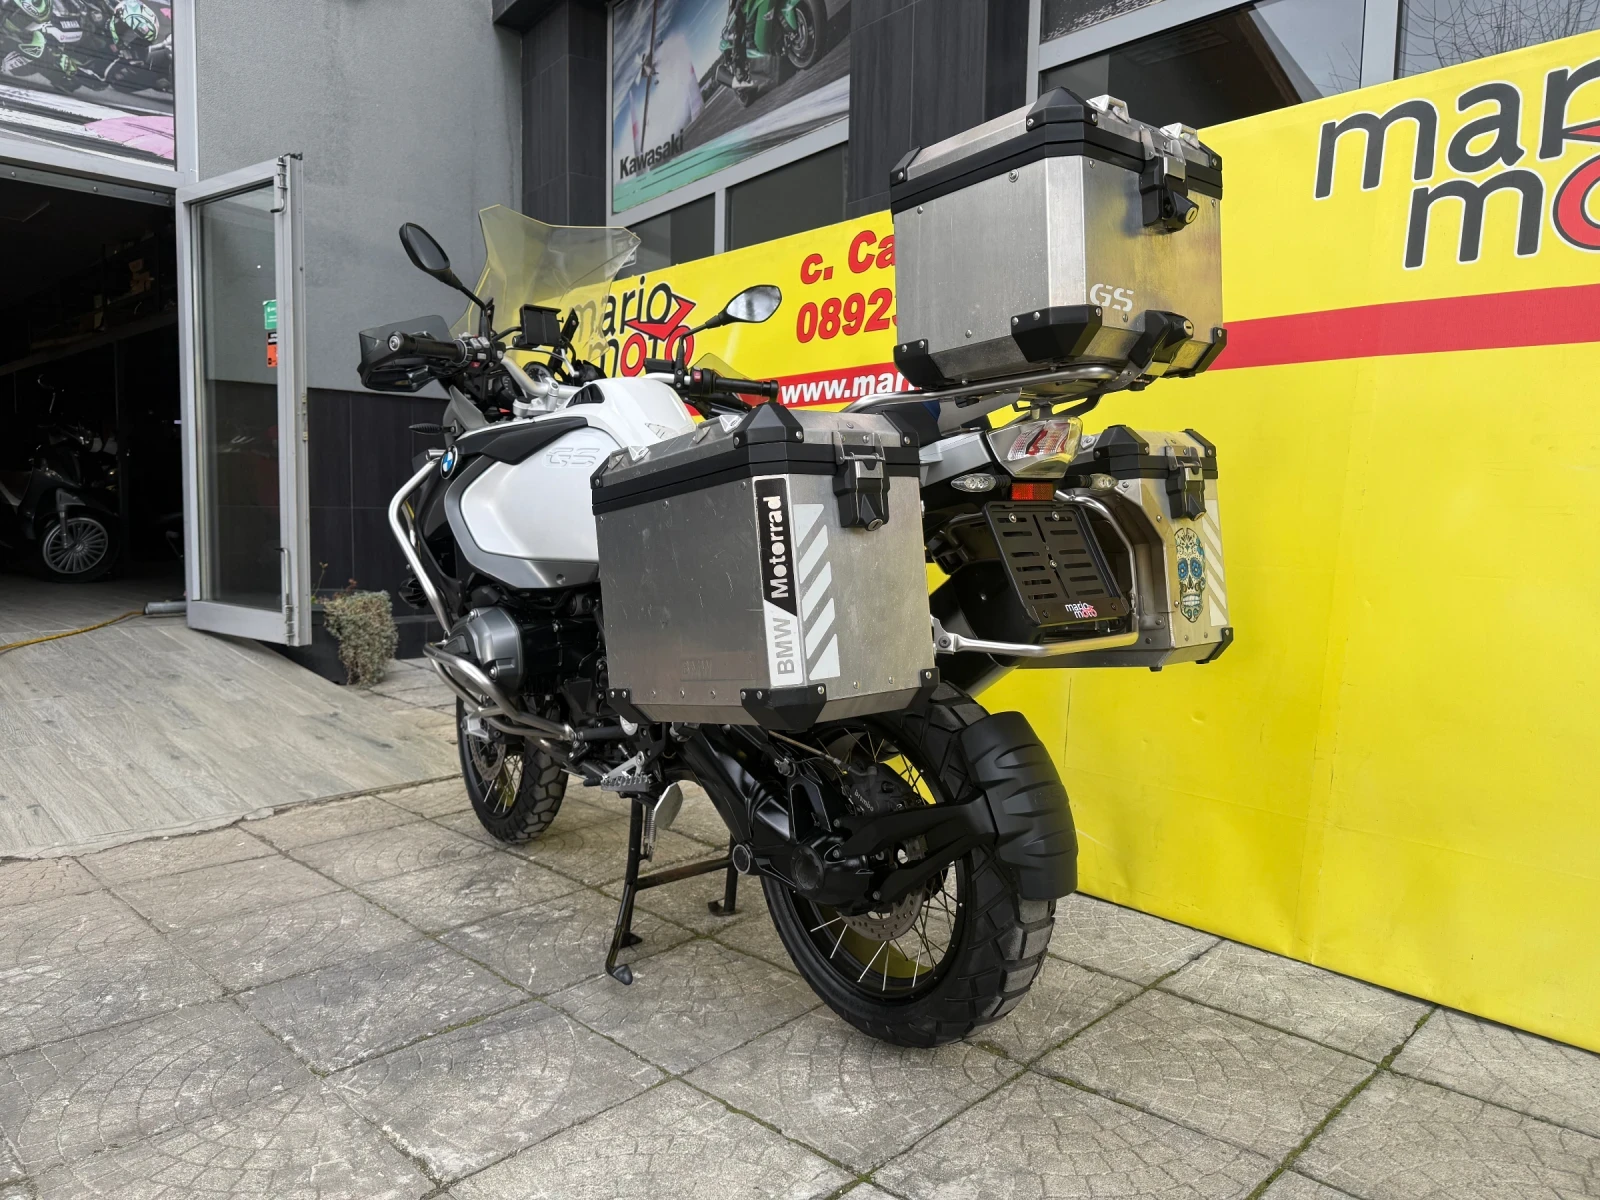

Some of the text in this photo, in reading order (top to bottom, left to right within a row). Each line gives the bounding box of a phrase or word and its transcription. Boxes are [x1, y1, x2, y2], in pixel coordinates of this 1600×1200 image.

[620, 128, 683, 179] Kawasaki
[571, 274, 673, 343] mario
[796, 287, 898, 344] 0892
[1090, 283, 1134, 312] GS
[763, 495, 795, 675] BMW Motorrad
[1064, 600, 1090, 613] mario
[1073, 608, 1098, 619] moto
[854, 788, 875, 812] brembo
